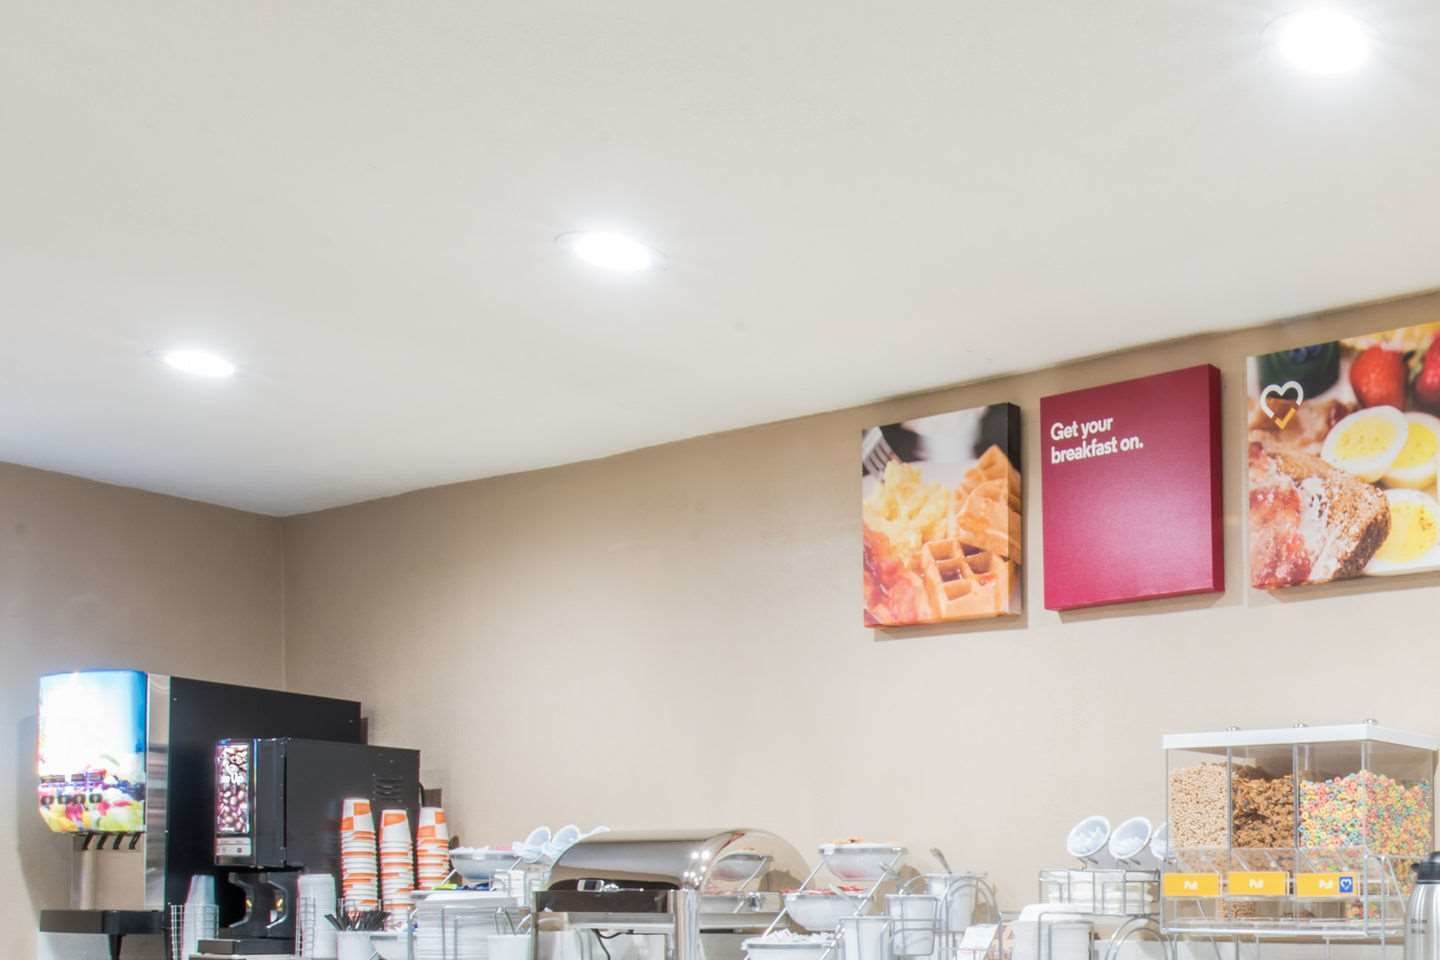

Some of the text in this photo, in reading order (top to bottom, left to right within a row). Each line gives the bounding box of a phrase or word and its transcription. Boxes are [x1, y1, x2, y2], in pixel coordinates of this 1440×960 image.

[1050, 417, 1114, 441] Get your
[1050, 436, 1144, 464] breakfast on.
